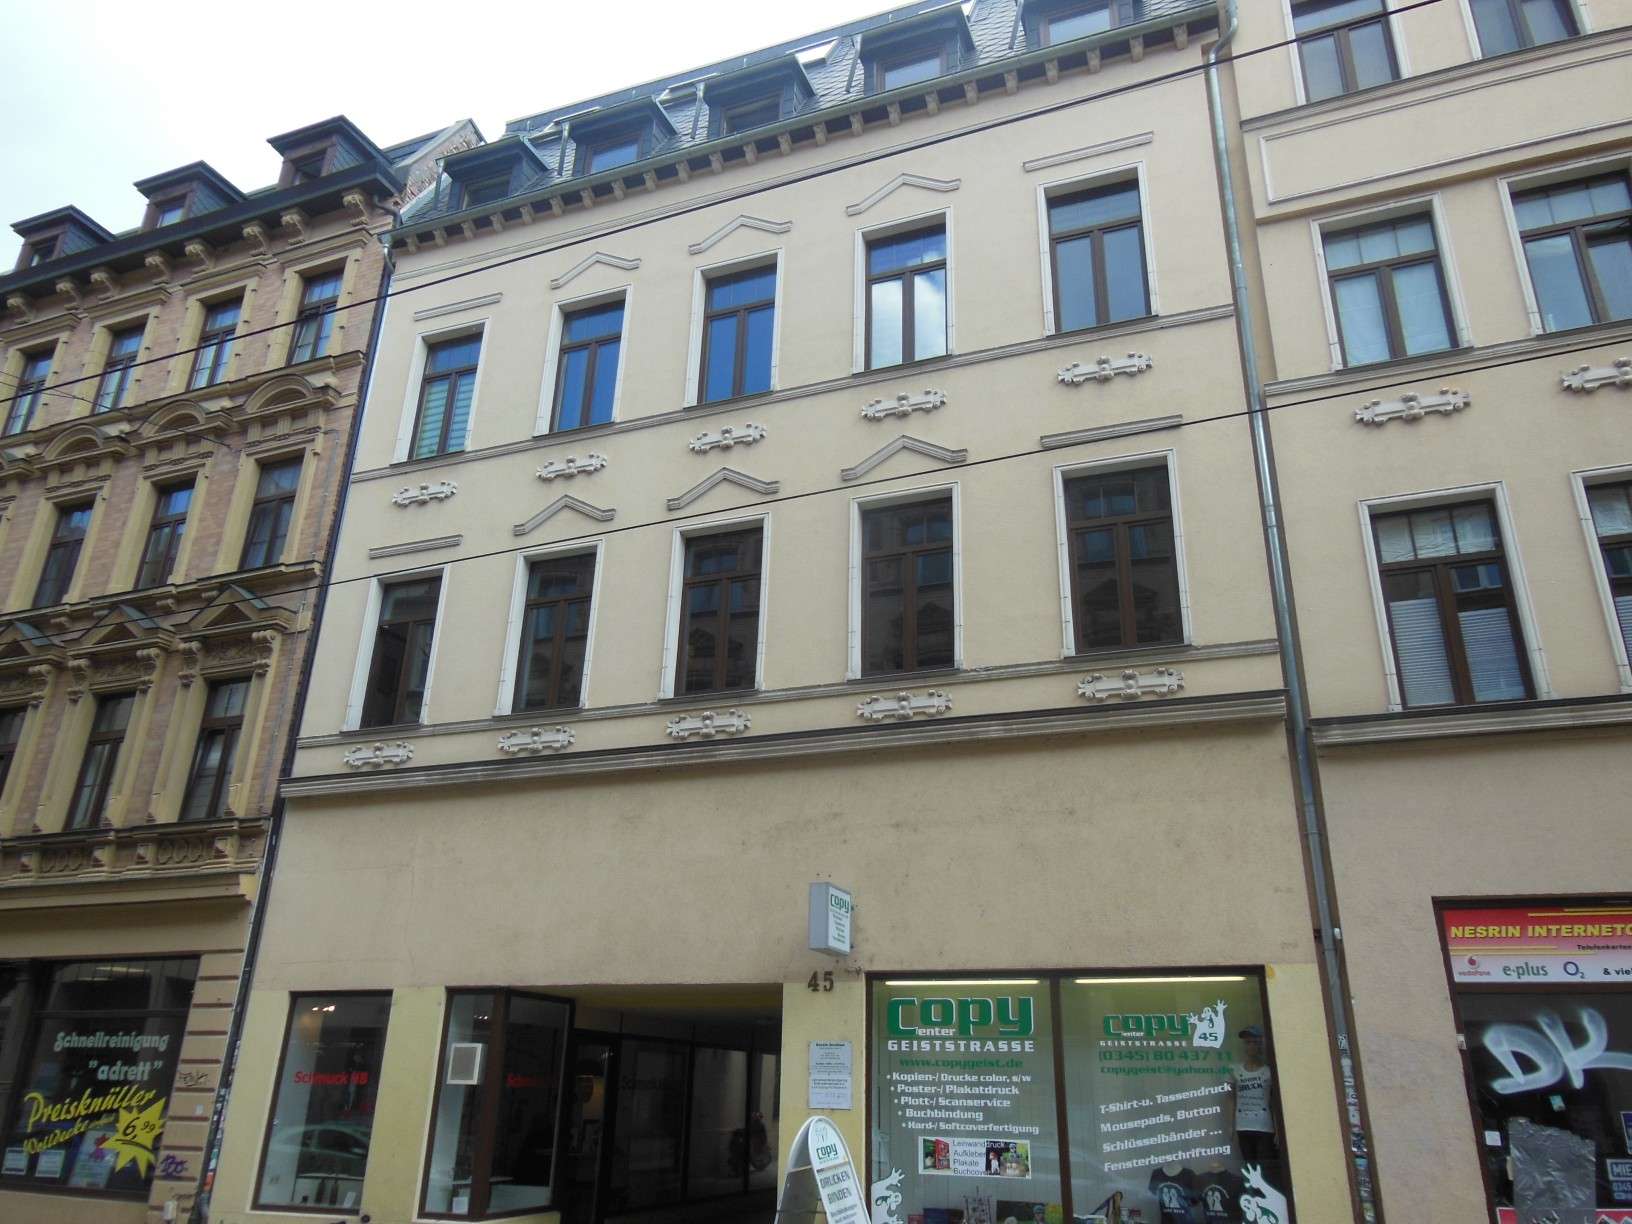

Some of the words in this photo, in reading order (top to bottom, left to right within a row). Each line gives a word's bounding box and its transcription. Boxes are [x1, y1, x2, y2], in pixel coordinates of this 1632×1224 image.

[830, 894, 850, 914] copy
[1450, 925, 1521, 938] NESRIN
[1602, 967, 1611, 975] &
[807, 970, 834, 992] 45
[886, 997, 1035, 1037] copy
[1103, 1014, 1191, 1037] copy
[54, 1032, 170, 1052] Schnellreinigung
[1198, 1032, 1218, 1041] 45
[887, 1040, 1035, 1052] GEISTSTRASSE
[899, 1057, 1024, 1070] www.copygeist.de
[940, 1073, 978, 1082] Drucke
[980, 1074, 1010, 1084] color,
[1012, 1073, 1032, 1083] s/w
[945, 1084, 1021, 1095] Plakatdruck
[1155, 1082, 1233, 1105] Tassendruck
[24, 1084, 157, 1132] Preisknüller
[938, 1097, 1012, 1107] Scanservice
[905, 1108, 984, 1121] Buchbindung
[1099, 1112, 1175, 1133] Mousepads,
[1176, 1105, 1221, 1119] Button
[939, 1122, 1040, 1136] Softcoverfertigung
[1102, 1127, 1208, 1153] Schlüsselbänder
[816, 1144, 838, 1160] copy
[1103, 1144, 1232, 1173] Fensterbeschriftung
[953, 1159, 979, 1167] Plakate
